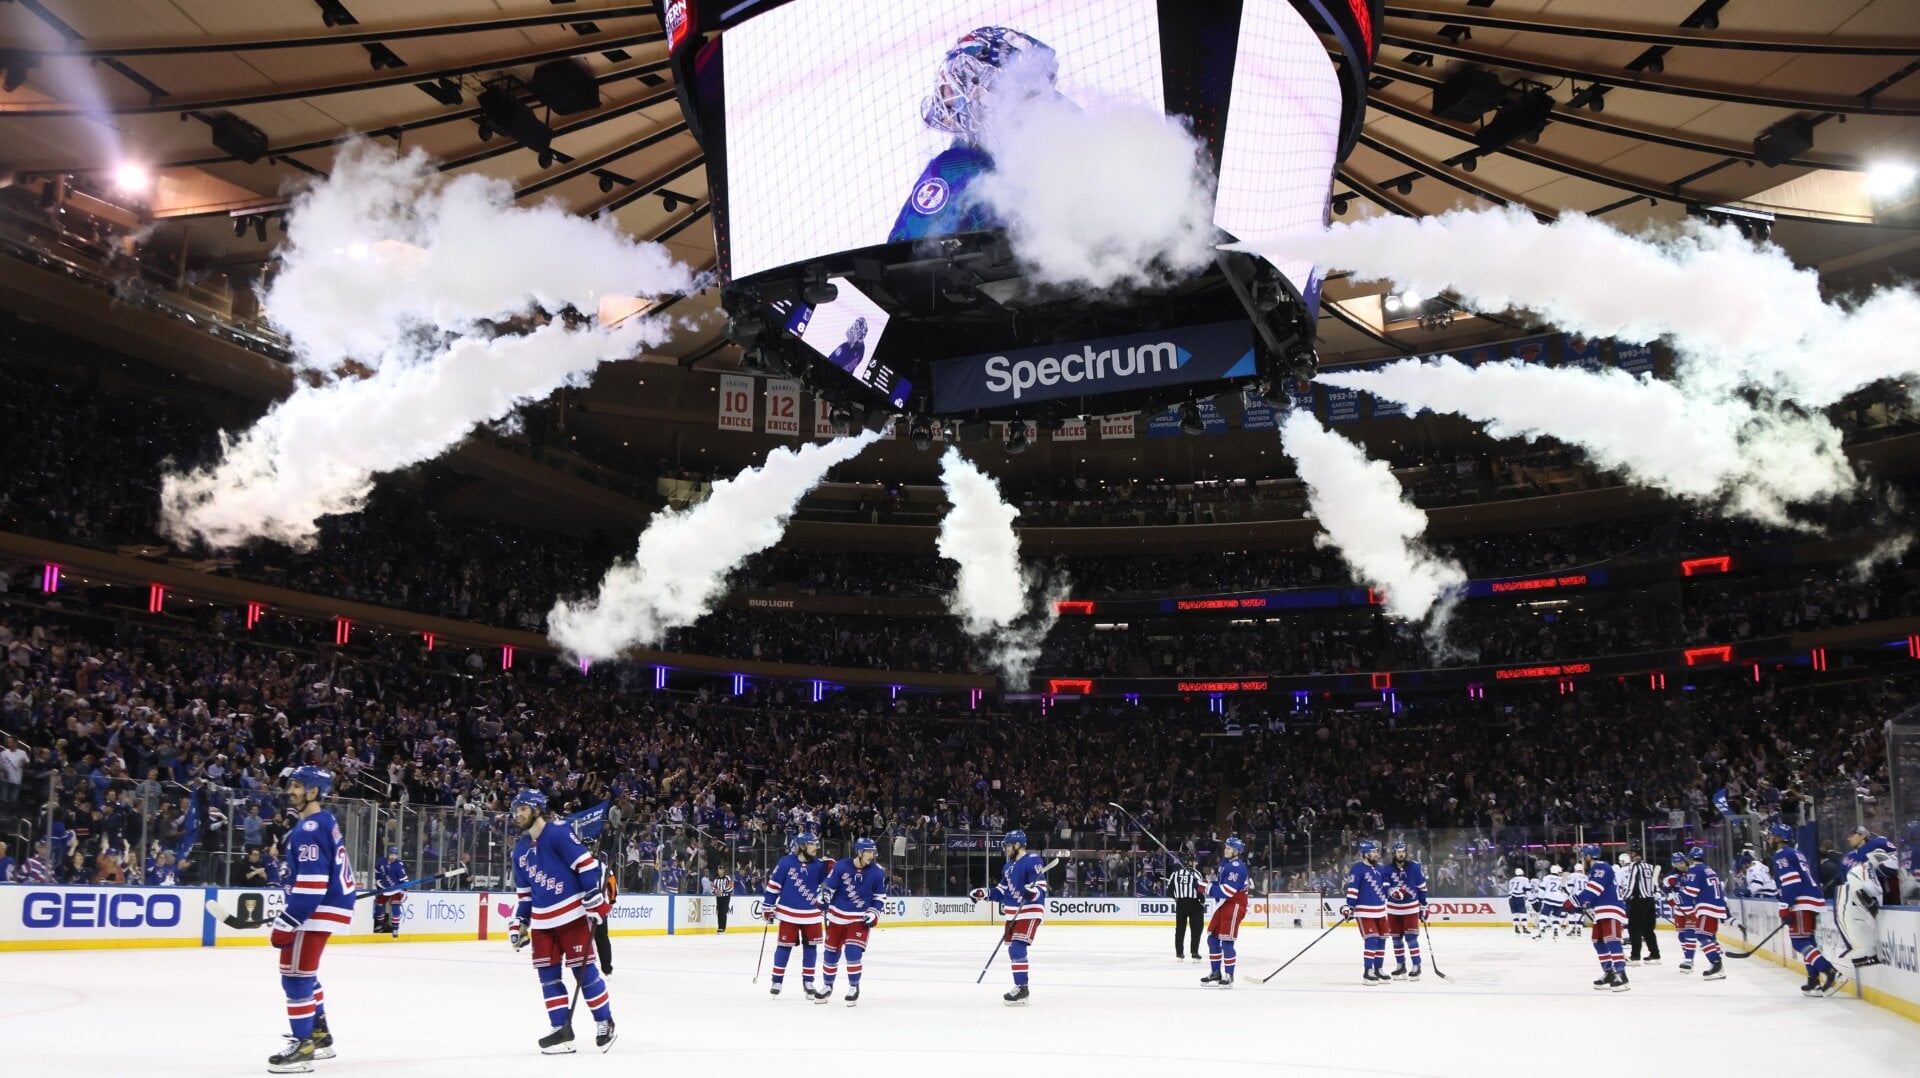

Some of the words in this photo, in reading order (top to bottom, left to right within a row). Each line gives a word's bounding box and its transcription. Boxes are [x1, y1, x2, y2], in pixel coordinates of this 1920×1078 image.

[984, 342, 1178, 399] Spectrum
[725, 391, 748, 413] 10
[771, 395, 794, 417] 12
[720, 415, 752, 428] KNICKS
[767, 420, 798, 432] KNICKS
[1102, 425, 1133, 435] KNICKS
[1492, 577, 1555, 592] RANGERS
[1558, 575, 1587, 587] WIN
[749, 599, 767, 607] BUD
[769, 600, 795, 608] LIGHT
[1178, 599, 1238, 609] RANGERS
[1240, 598, 1266, 608] WIN
[1496, 665, 1560, 680] RANGERS
[1562, 664, 1590, 674] WIN
[1178, 681, 1239, 691] RANGERS
[1241, 681, 1267, 691] WIN
[298, 844, 320, 862] 20
[1179, 875, 1189, 884] 79
[1686, 873, 1696, 882] 77
[22, 892, 182, 928] GEICO
[426, 900, 466, 920] Infosys
[1050, 900, 1116, 916] Spectrum
[1140, 903, 1169, 913] BUD
[1427, 903, 1496, 915] ONDA
